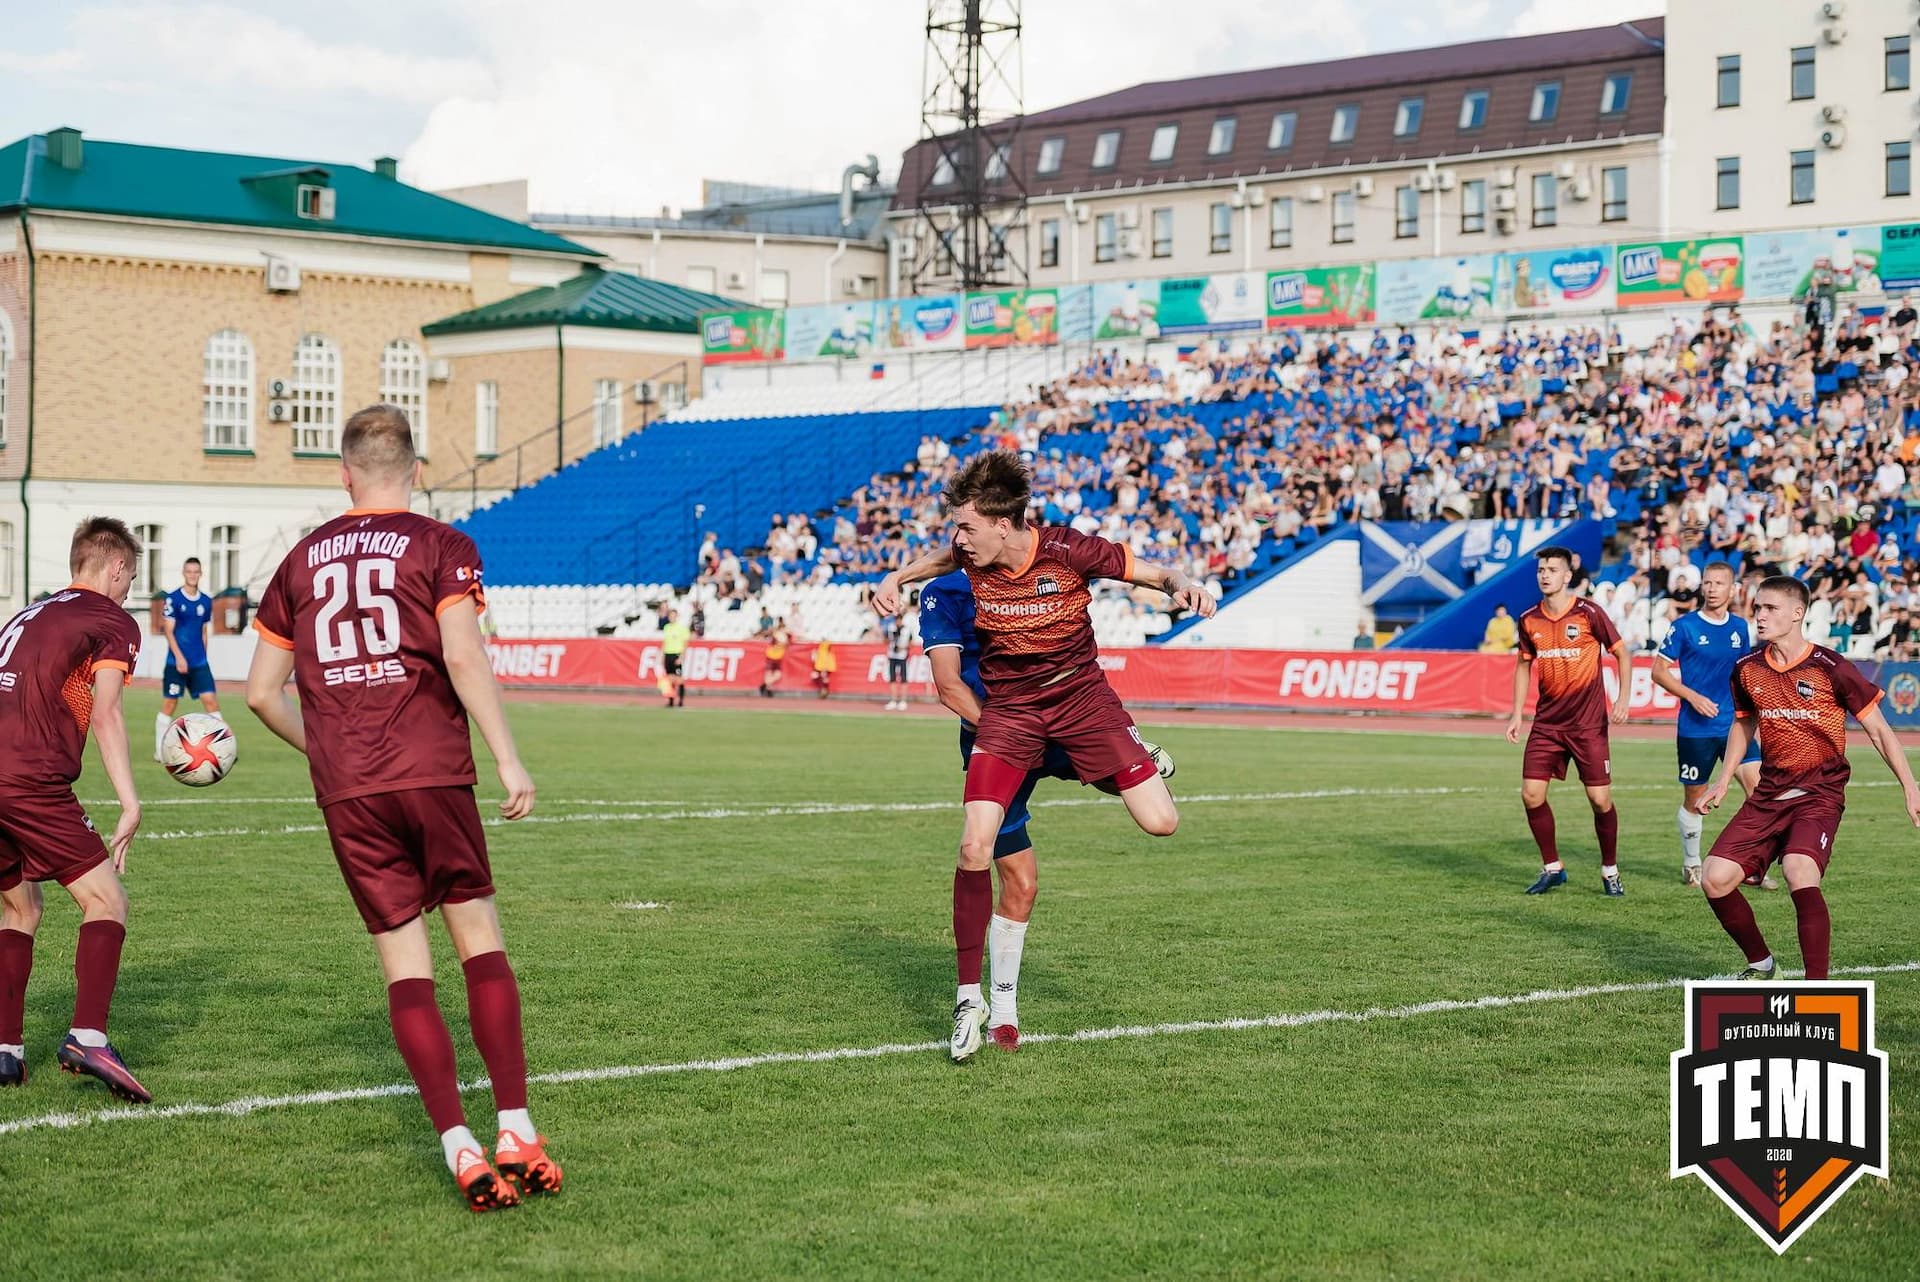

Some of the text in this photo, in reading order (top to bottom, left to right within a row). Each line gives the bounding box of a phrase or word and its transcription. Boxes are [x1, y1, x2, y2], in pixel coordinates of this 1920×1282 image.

[308, 532, 410, 568] НОВИЧКОВ
[1037, 582, 1058, 596] ТЕМП
[312, 557, 400, 664] 25
[324, 659, 406, 686] SEUS
[1278, 658, 1427, 700] FONBET
[1680, 764, 1699, 780] 20
[1820, 831, 1828, 850] 4
